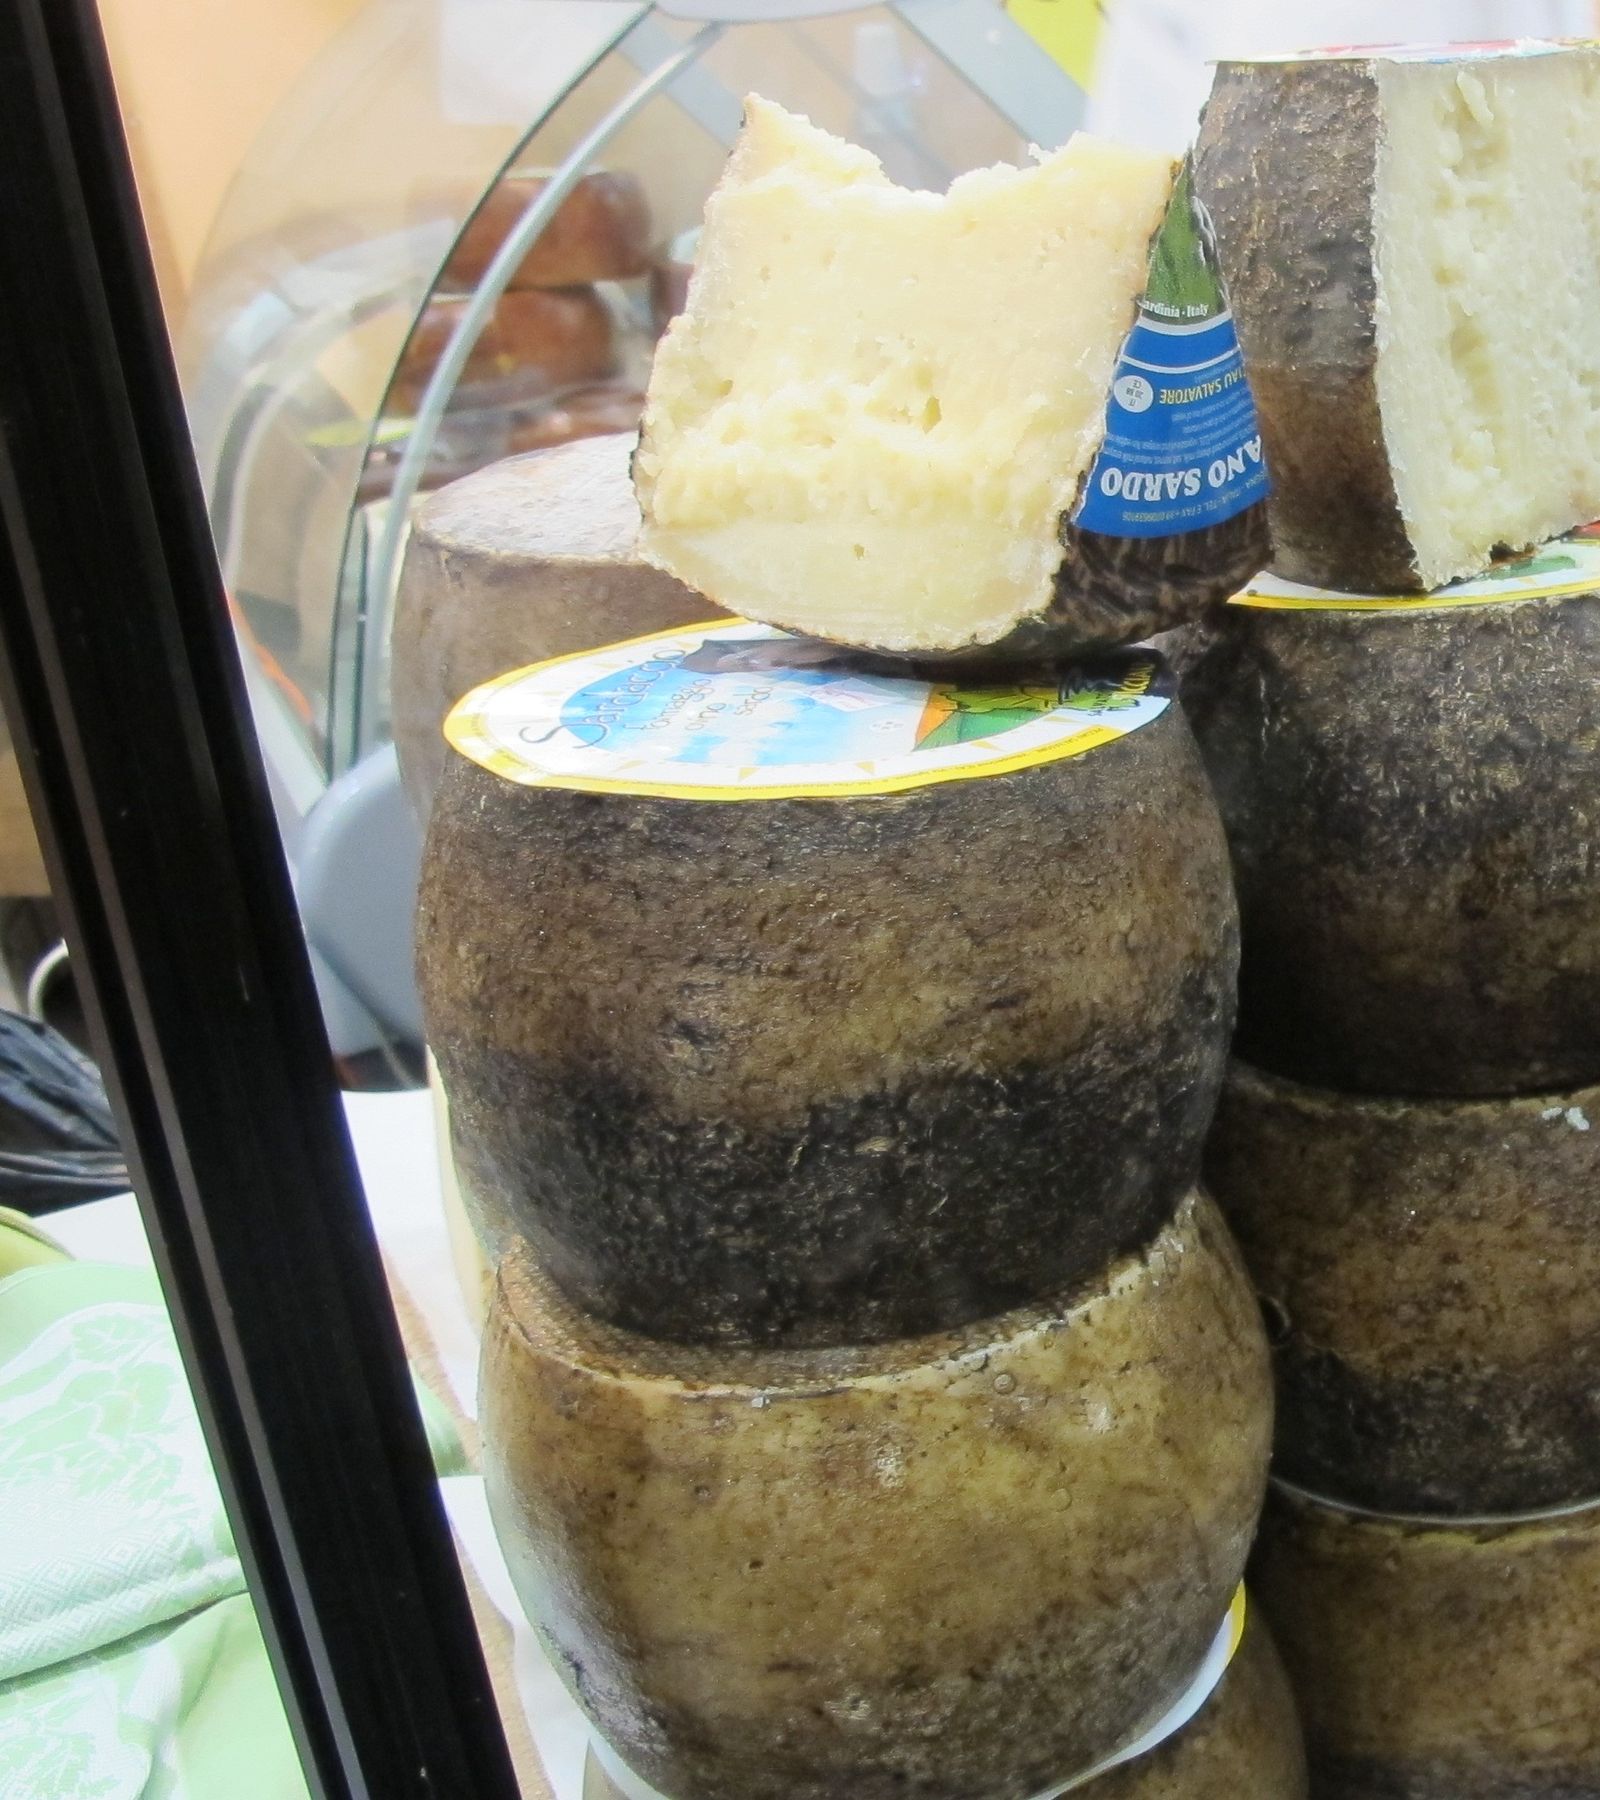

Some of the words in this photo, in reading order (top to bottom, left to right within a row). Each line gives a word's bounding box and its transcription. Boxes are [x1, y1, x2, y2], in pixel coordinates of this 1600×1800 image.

[1139, 299, 1180, 318] ardinia
[1186, 303, 1209, 318] Italy
[1159, 377, 1222, 404] SALVATORE
[1207, 434, 1262, 488] ANO
[1100, 466, 1201, 502] SARDO
